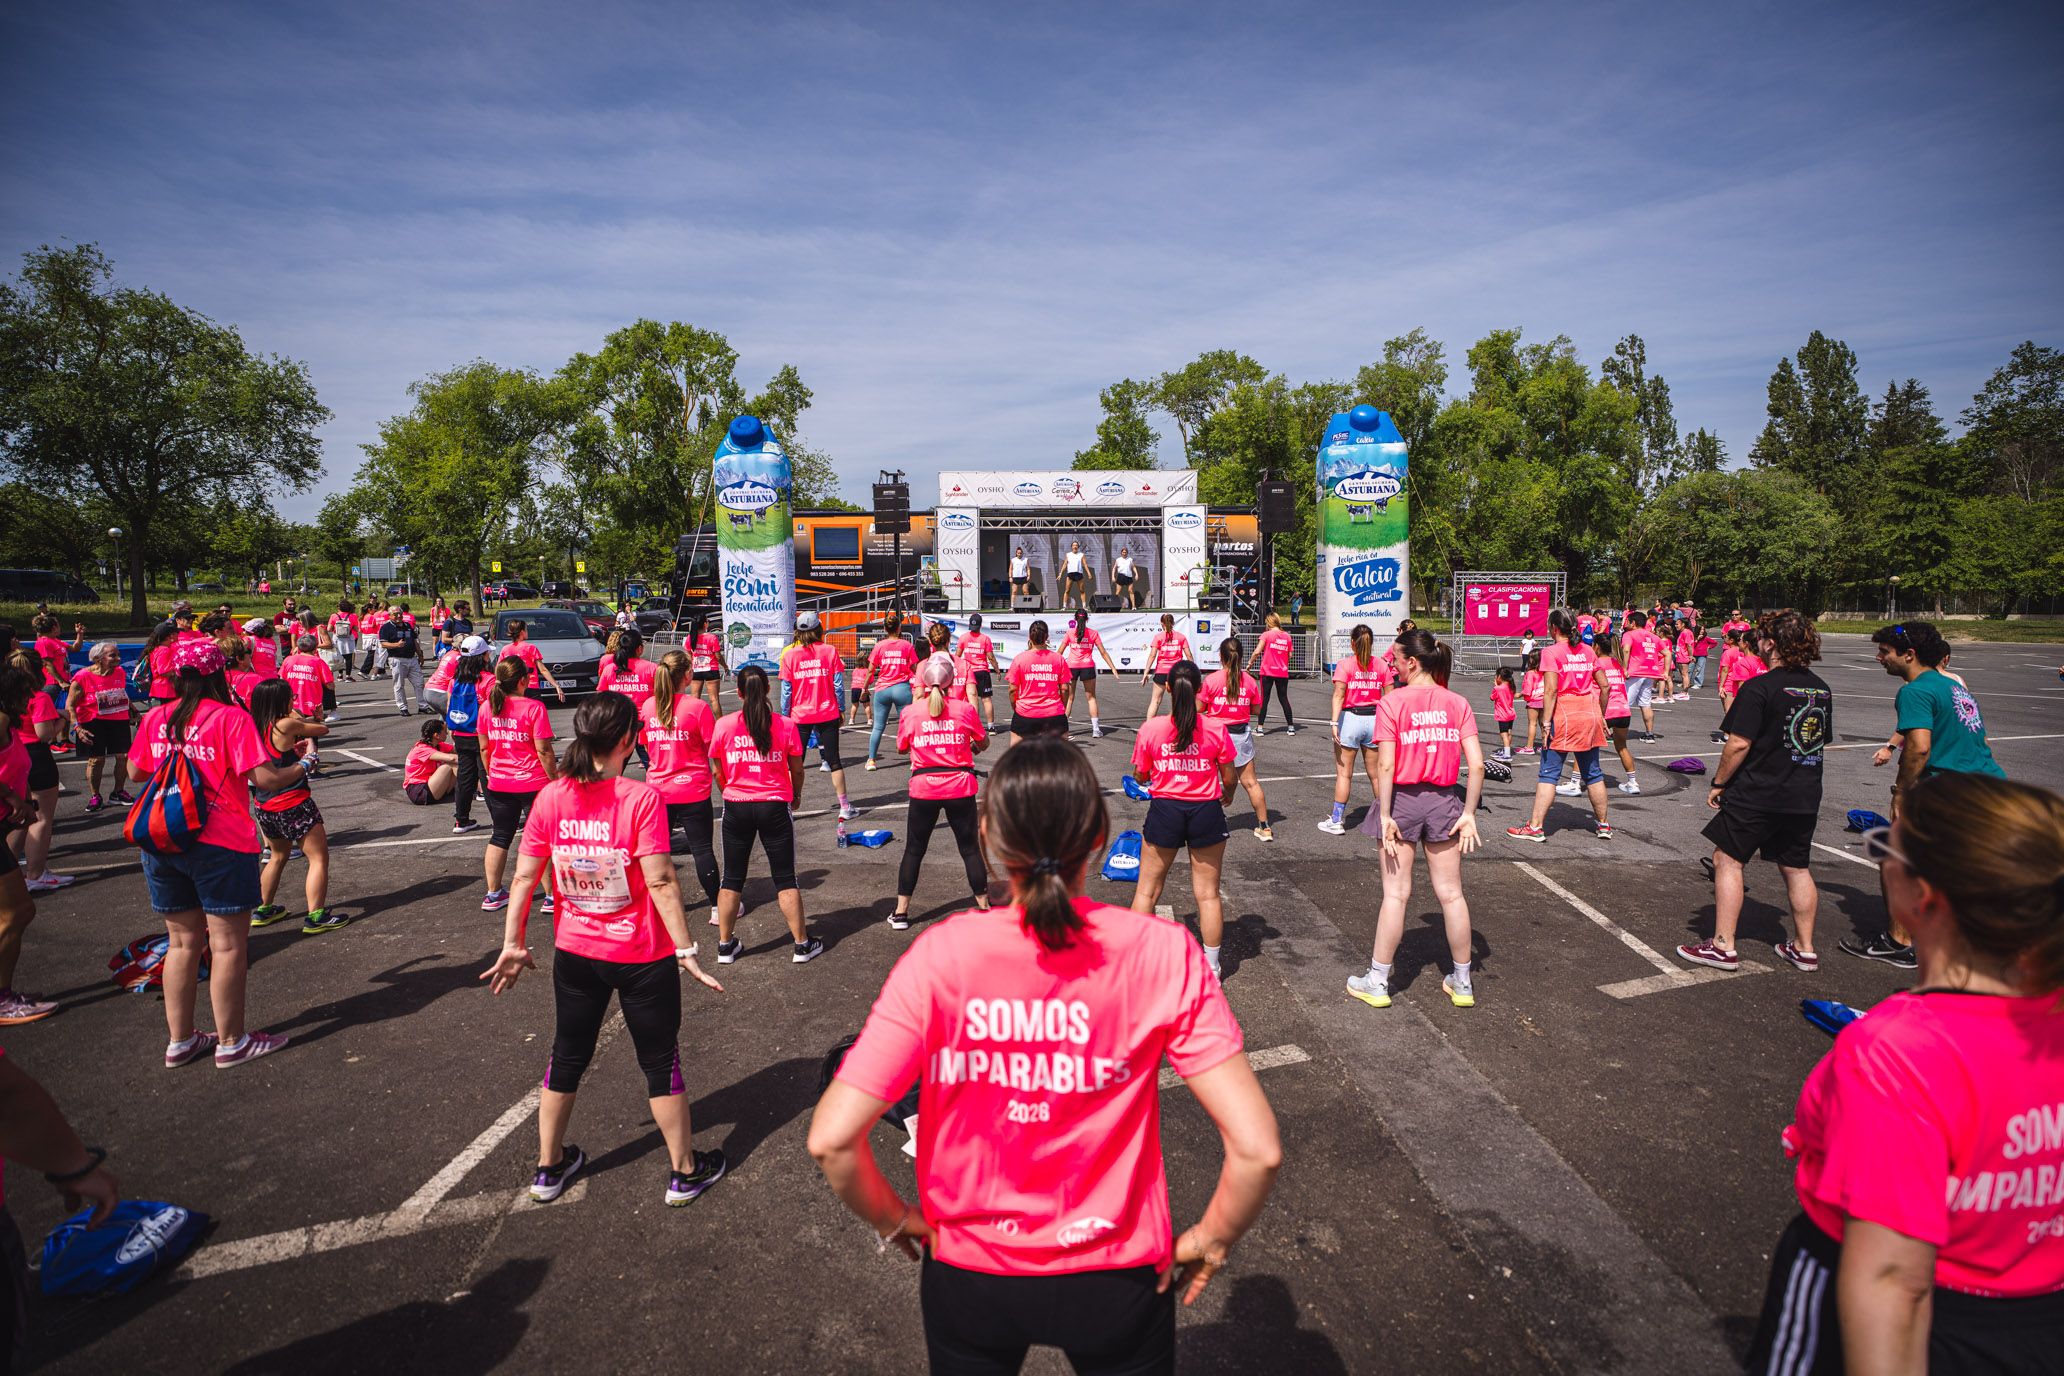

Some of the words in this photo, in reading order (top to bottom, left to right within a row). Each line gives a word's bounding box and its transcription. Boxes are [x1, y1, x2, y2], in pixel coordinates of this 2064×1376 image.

[1339, 484, 1396, 494] ASTURIANA
[722, 492, 774, 503] ASTURIANA
[726, 561, 754, 579] Leche
[724, 574, 781, 598] semi
[1339, 565, 1393, 592] Calcio
[1362, 589, 1392, 602] natural
[726, 596, 783, 613] desnatada
[1341, 608, 1392, 618] semidesnatada
[800, 659, 821, 669] SOMOS
[616, 674, 639, 682] SOMOS
[492, 717, 517, 729] SOMOS
[1411, 710, 1448, 726] SOMOS
[922, 720, 954, 732] SOMOS
[914, 733, 965, 748] IMPARABLES
[559, 819, 610, 842] SOMOS
[966, 998, 1090, 1044] SOMOS
[930, 1046, 1132, 1094] IMPARABLES
